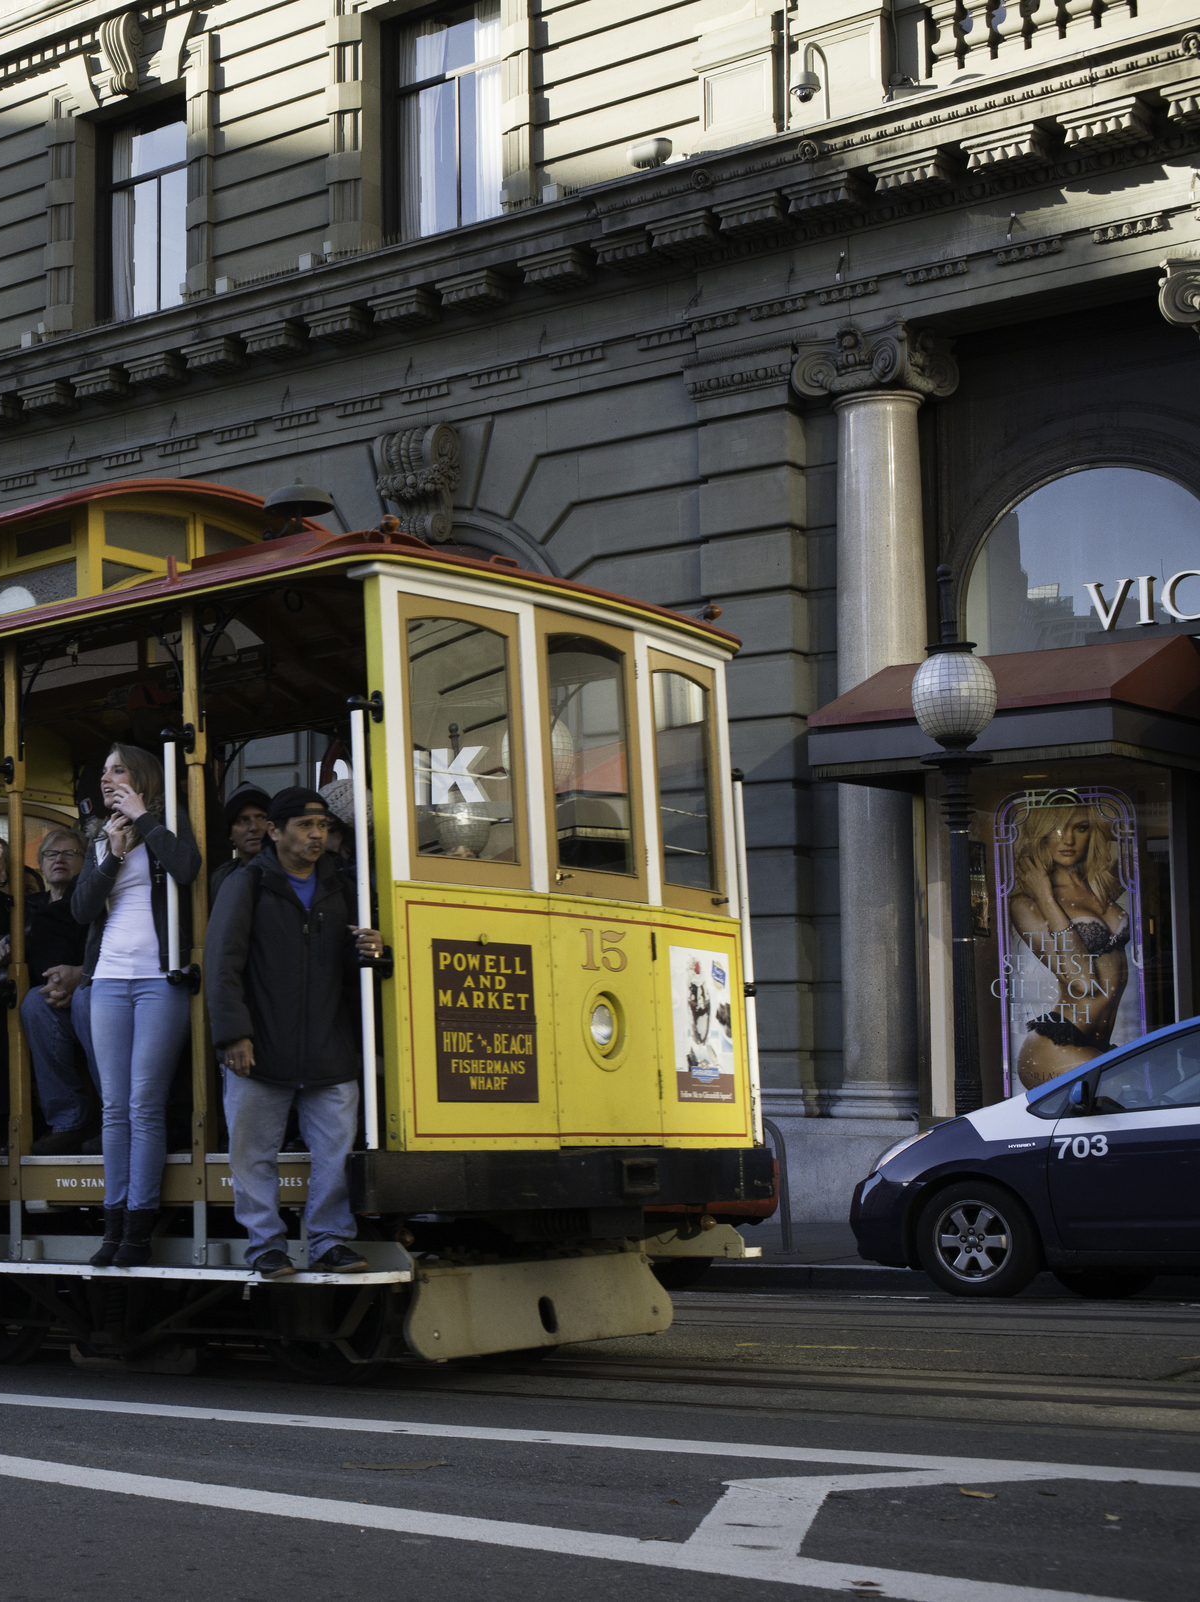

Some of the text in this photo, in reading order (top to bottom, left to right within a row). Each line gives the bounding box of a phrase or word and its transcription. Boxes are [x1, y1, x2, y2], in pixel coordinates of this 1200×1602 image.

[579, 927, 628, 973] 15
[1022, 931, 1075, 952] THE
[438, 952, 527, 975] POWELL
[1002, 954, 1100, 975] SEXIEST
[463, 974, 507, 990] AND
[990, 978, 1111, 1000] GIFTS ON
[438, 989, 530, 1011] MARKET
[1009, 1002, 1092, 1024] EARTH
[442, 1031, 474, 1053] HYDE
[493, 1033, 533, 1055] BEACH
[451, 1058, 526, 1075] FISHERMANS
[469, 1076, 508, 1091] WHARF
[1053, 1134, 1109, 1160] 703
[55, 1177, 104, 1188] TWO STAN
[220, 1177, 234, 1187] TW
